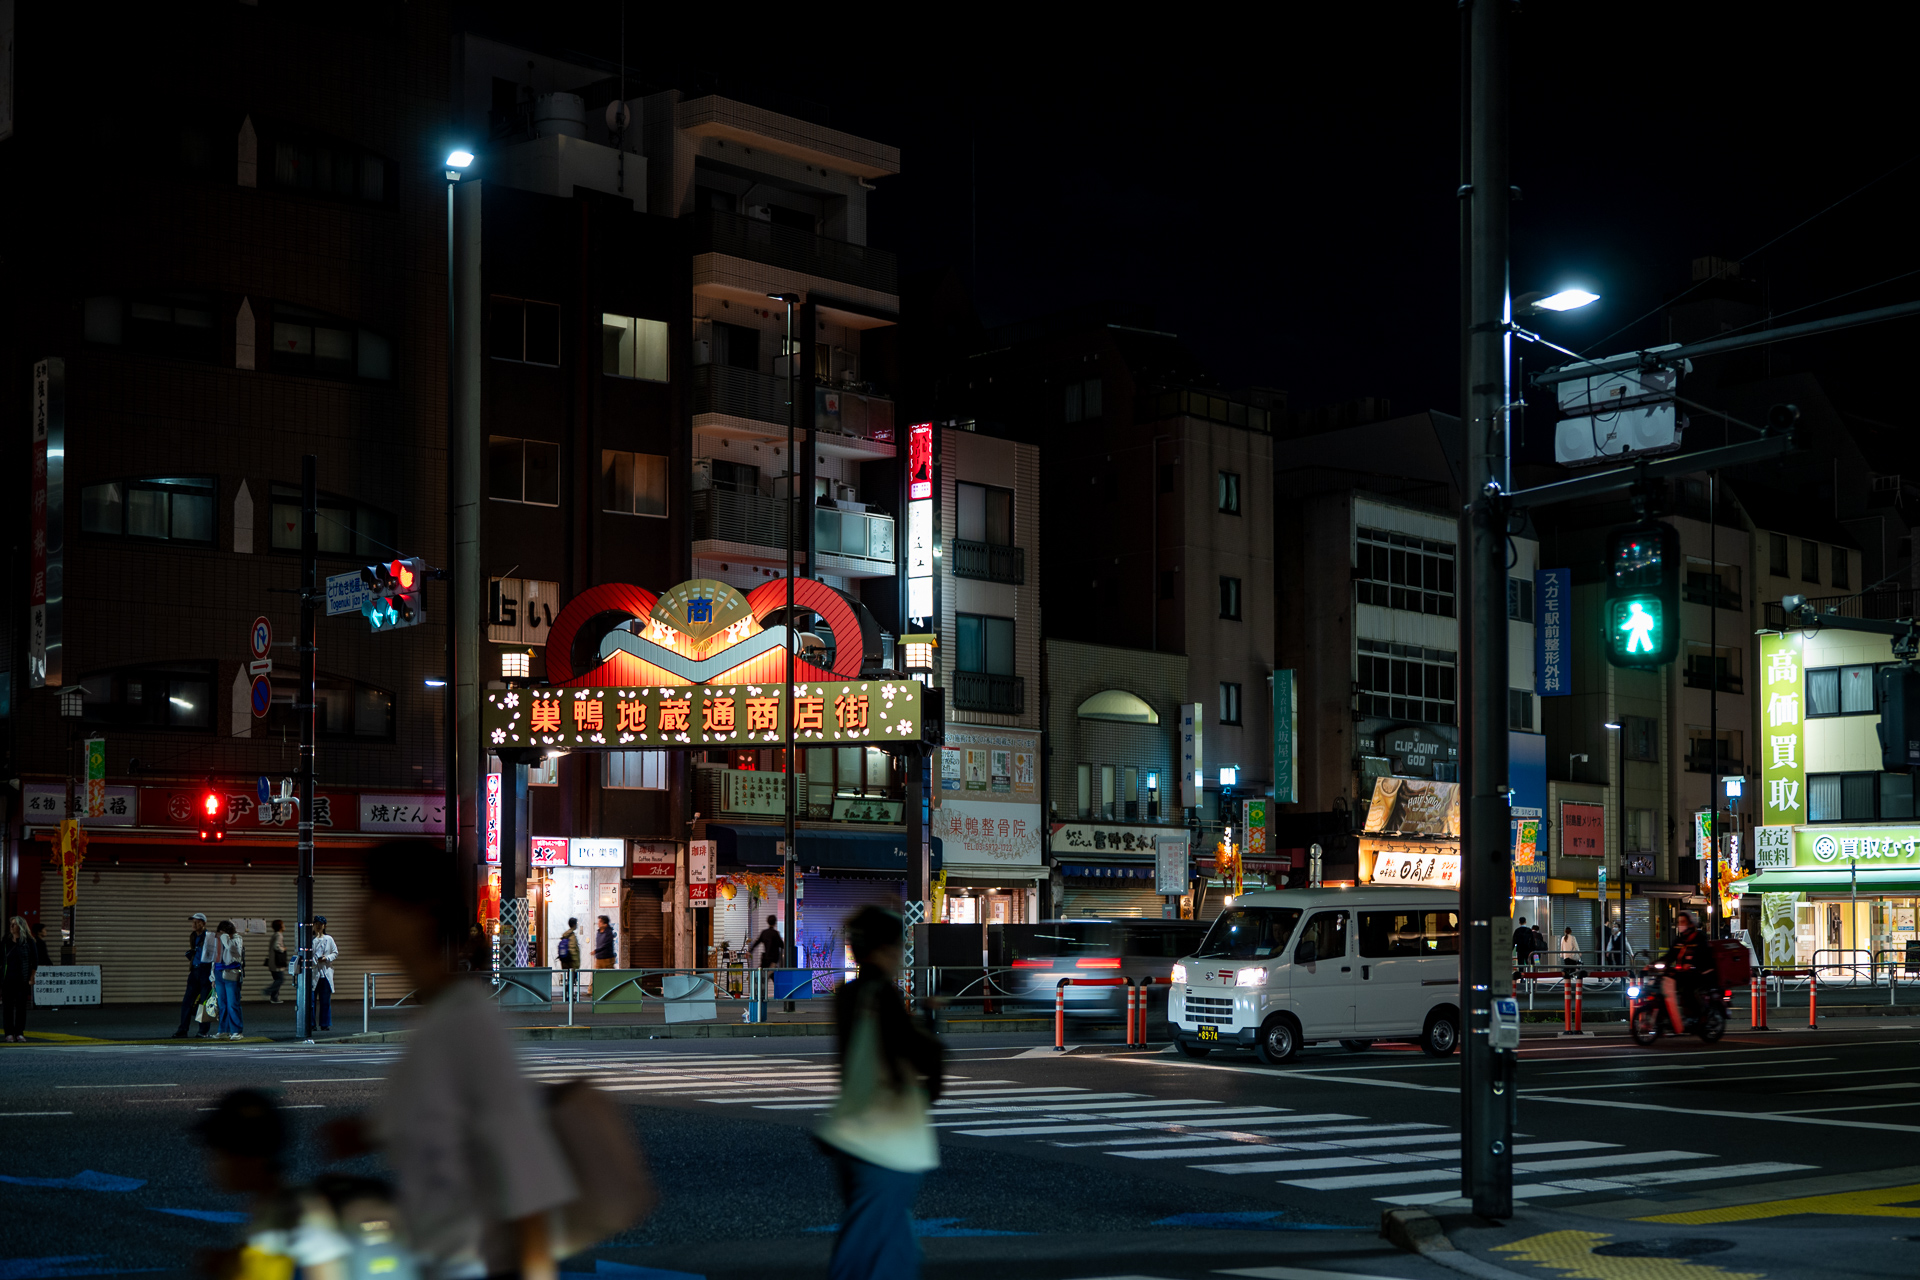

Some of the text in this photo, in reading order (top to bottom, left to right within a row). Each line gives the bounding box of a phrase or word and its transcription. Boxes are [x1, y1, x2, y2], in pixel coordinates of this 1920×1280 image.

[686, 596, 714, 624] 商
[1544, 573, 1560, 691] スガモ駅前整形外科
[530, 693, 870, 734] 巣鴨地蔵通商店街
[1766, 649, 1801, 812] 高価買取
[1277, 716, 1290, 800] 大坂屋プラザ
[1394, 740, 1439, 755] CLIP JOINT
[1407, 754, 1426, 766] GOD
[29, 797, 56, 811] 名物
[949, 816, 1027, 838] 巣鴨整骨院
[1756, 828, 1790, 847] 査定
[691, 845, 707, 857] 珈琲
[1757, 847, 1790, 867] 無料
[1399, 857, 1436, 881] 日高屋
